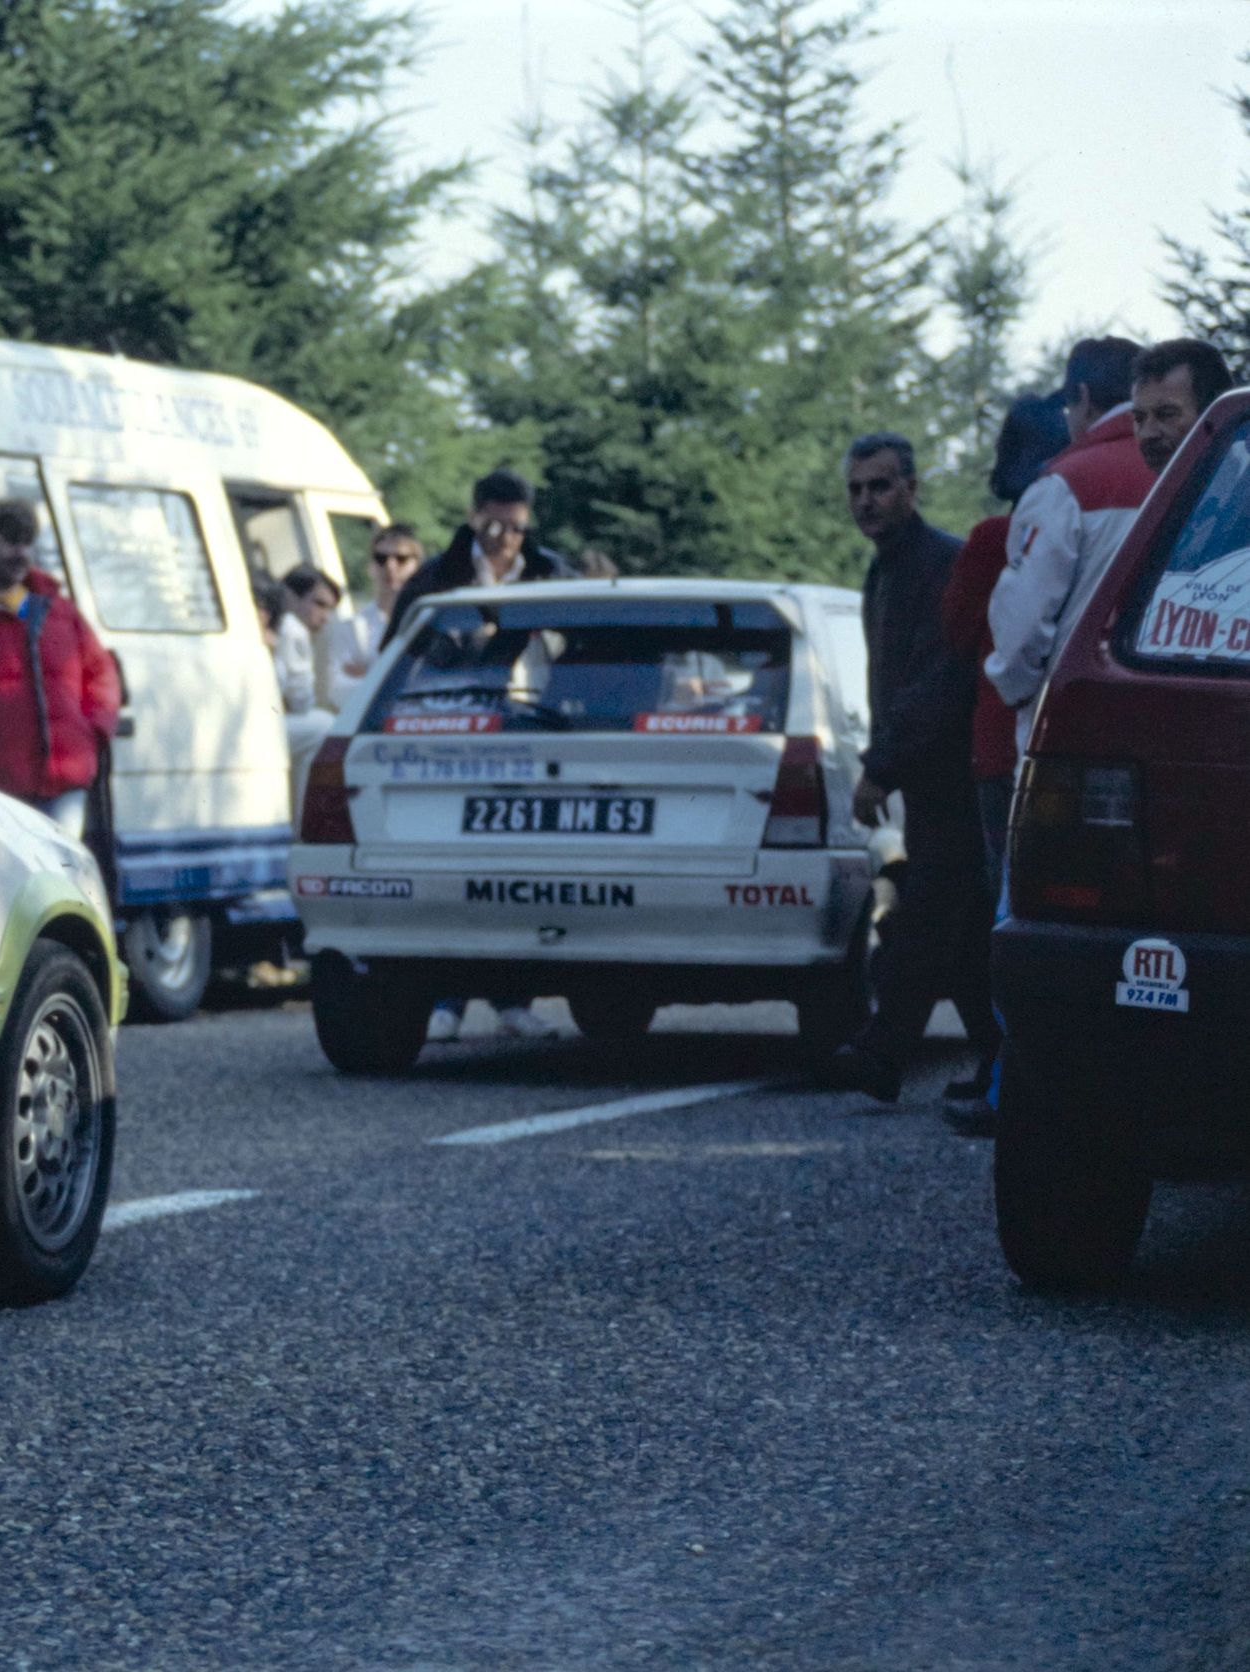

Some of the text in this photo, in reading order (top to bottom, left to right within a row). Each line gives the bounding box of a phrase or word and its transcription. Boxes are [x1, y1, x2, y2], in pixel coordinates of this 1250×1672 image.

[1192, 591, 1229, 602] LYON
[1150, 598, 1250, 652] LYON-C
[470, 799, 646, 832] 2261 NM 69
[465, 879, 635, 907] MICHELIN
[724, 884, 815, 906] TOTAL
[1133, 946, 1178, 981] RTL
[1157, 990, 1178, 1007] FM
